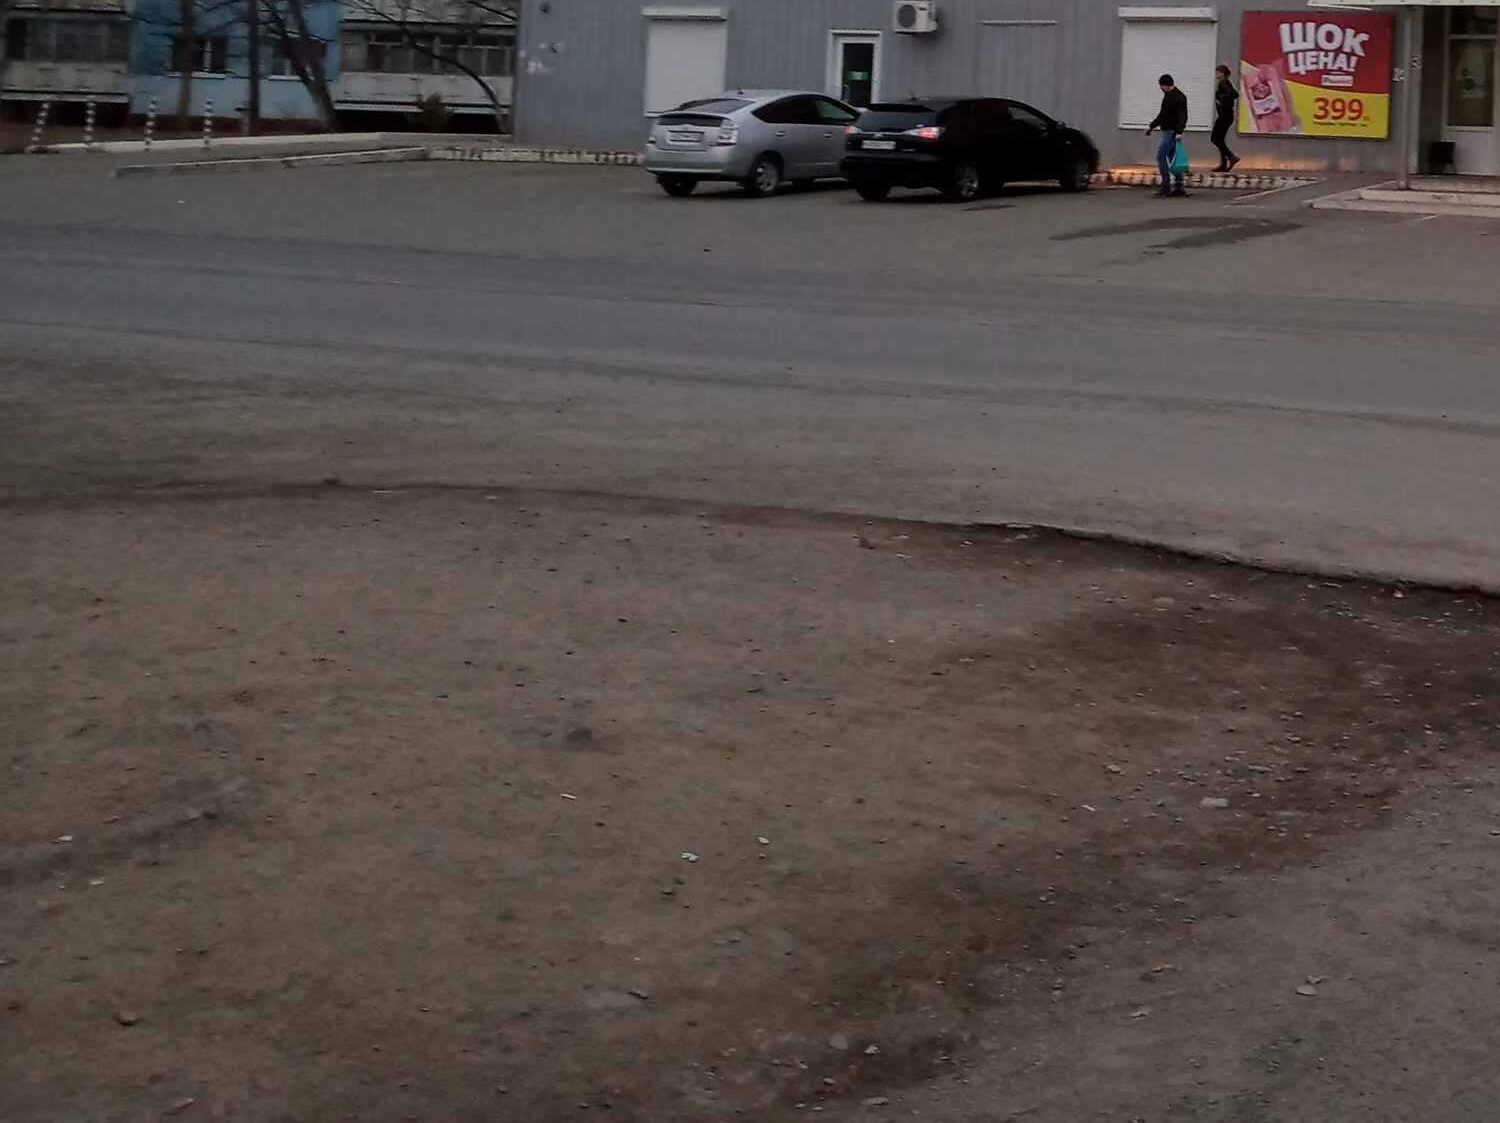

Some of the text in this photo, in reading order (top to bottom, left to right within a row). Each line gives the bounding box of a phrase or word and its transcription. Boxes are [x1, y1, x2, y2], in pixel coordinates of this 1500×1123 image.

[1279, 22, 1371, 57] ШОК
[1287, 50, 1359, 75] ЦЕНА!
[1312, 96, 1364, 122] 399
